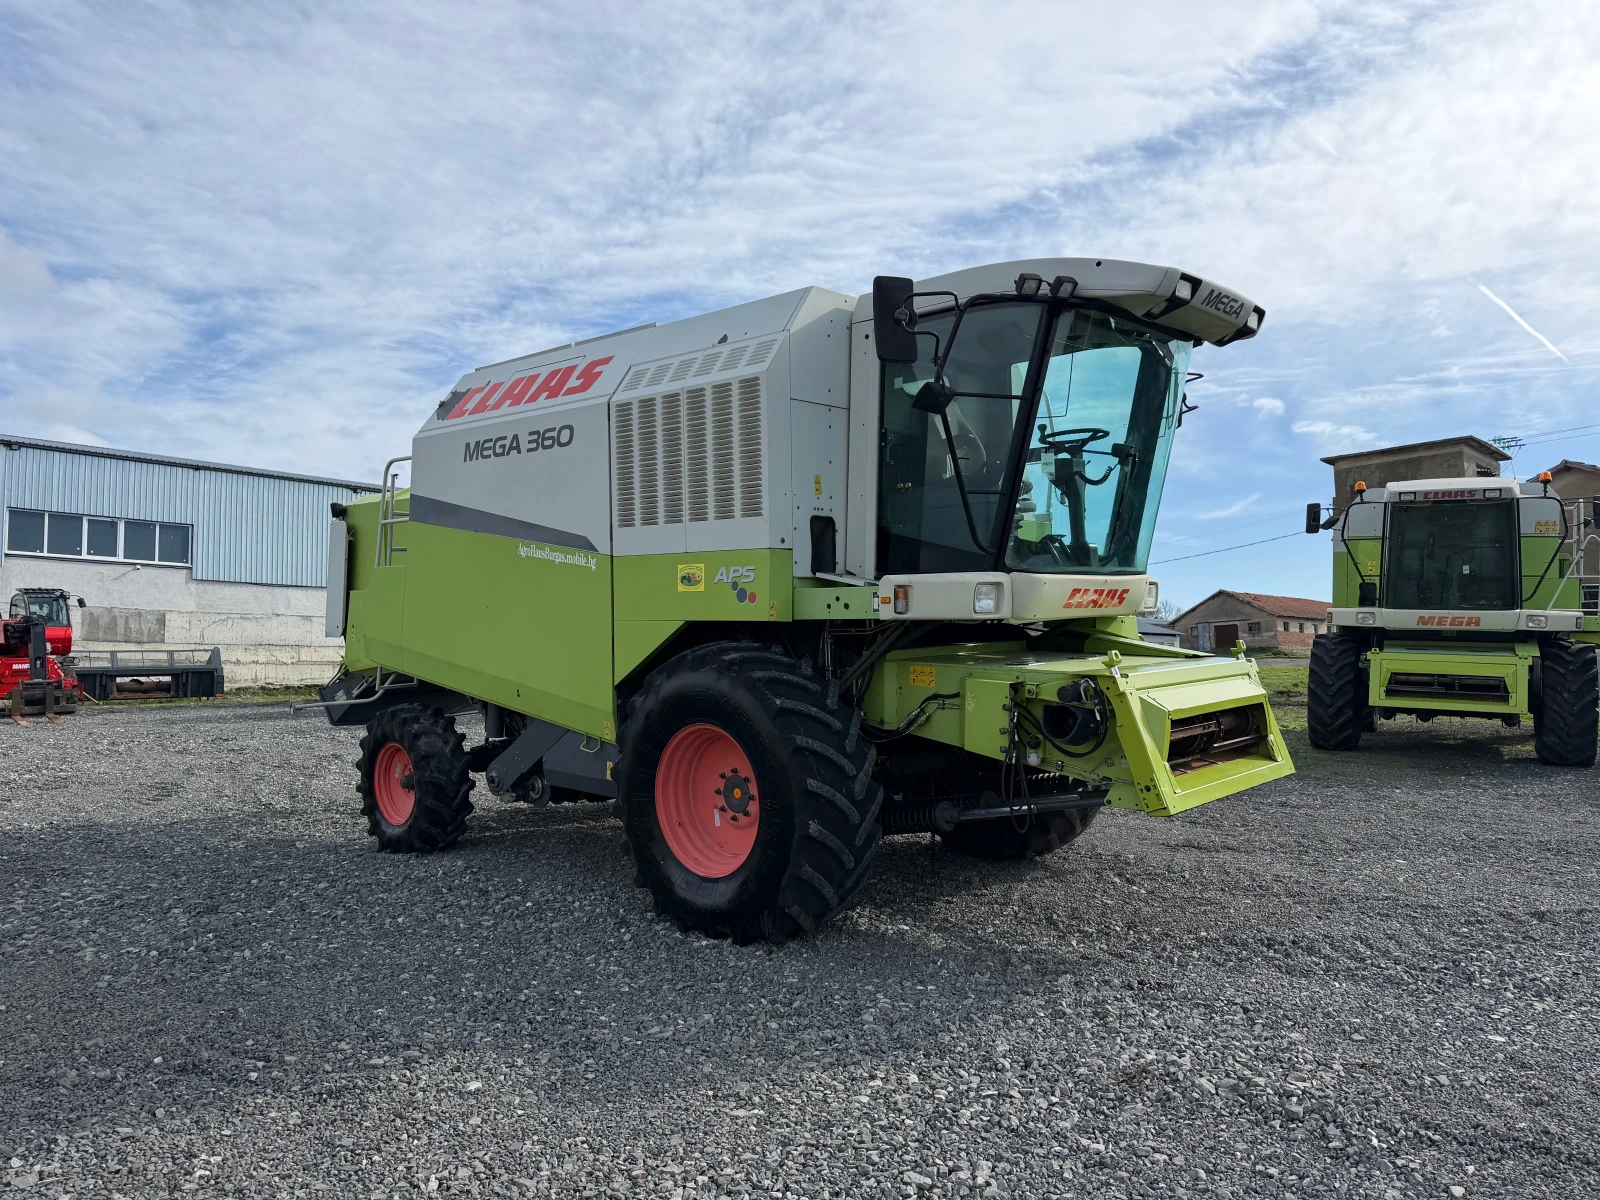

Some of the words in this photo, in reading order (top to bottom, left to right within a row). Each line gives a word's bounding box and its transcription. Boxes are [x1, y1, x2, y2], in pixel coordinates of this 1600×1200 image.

[1200, 288, 1245, 320] MEGA
[445, 355, 616, 420] CLAAS
[463, 433, 522, 463] MEGA
[526, 424, 575, 453] 360
[1423, 490, 1477, 500] CLAAS
[517, 542, 597, 571] AgroHausBurgas.mobile.bg
[714, 565, 756, 584] APS
[1062, 588, 1131, 609] CLAAS
[1416, 615, 1481, 627] MEGA
